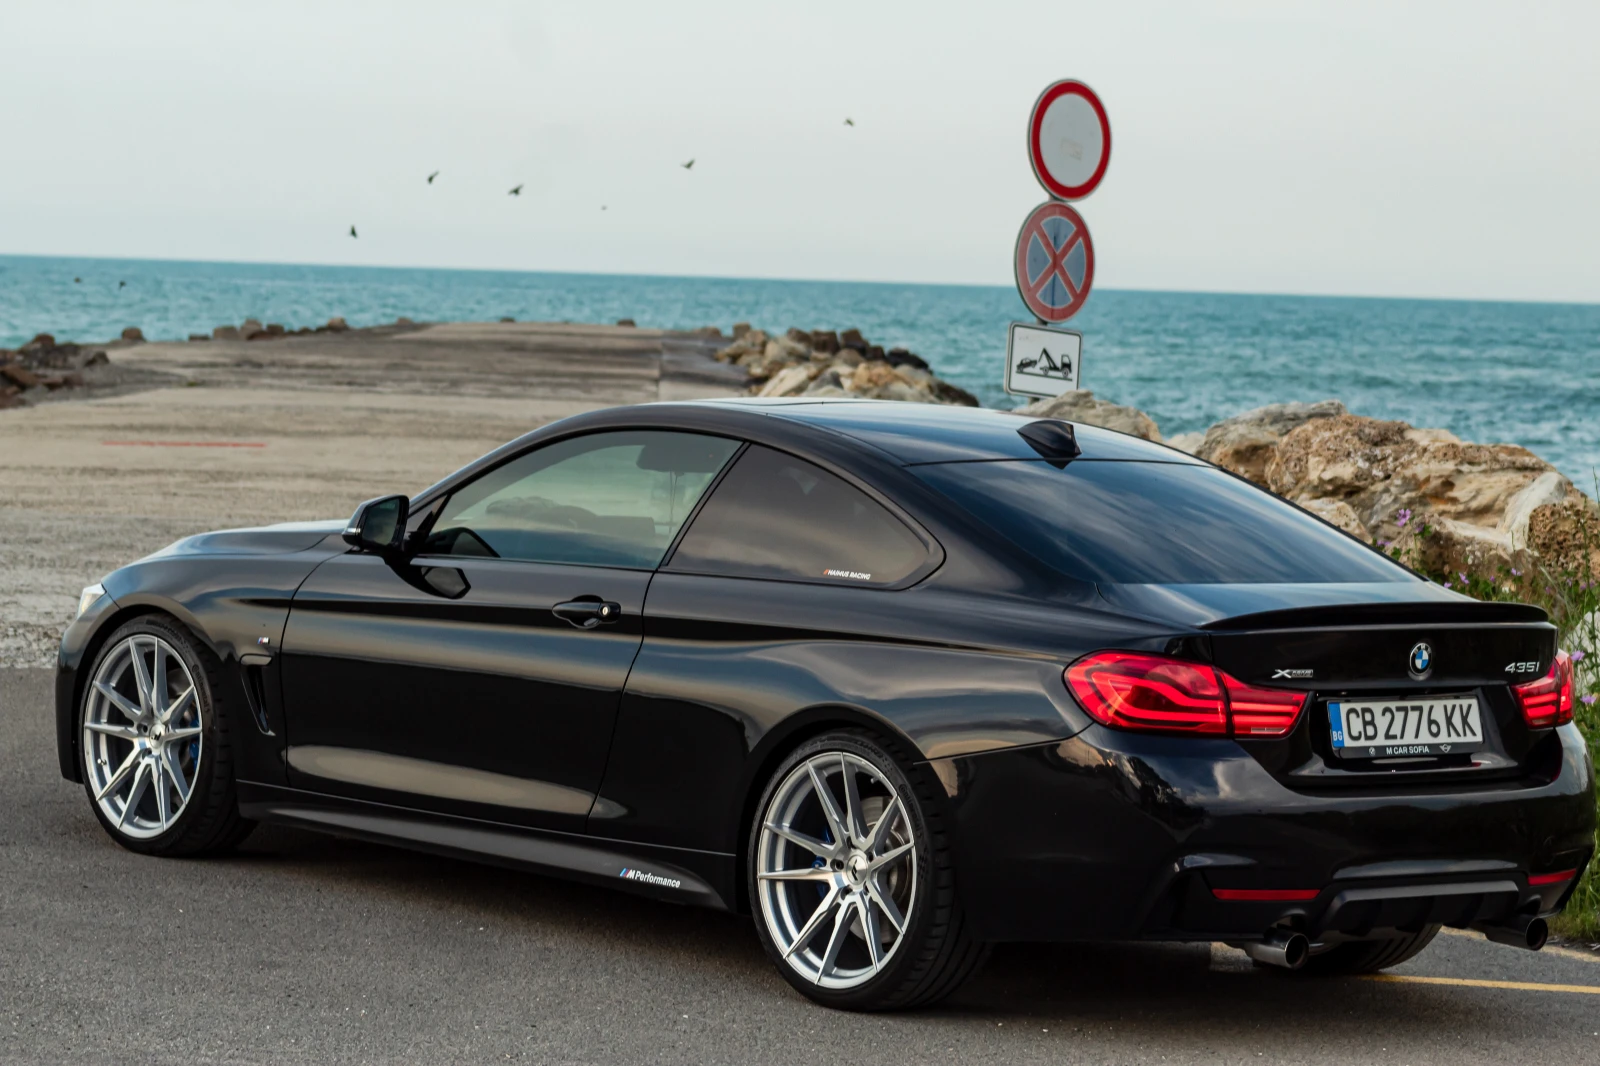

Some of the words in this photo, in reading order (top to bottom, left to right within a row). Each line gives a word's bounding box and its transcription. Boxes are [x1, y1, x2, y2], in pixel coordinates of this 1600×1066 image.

[850, 571, 871, 580] RACING
[1345, 706, 1378, 741] CB
[1381, 705, 1441, 740] 2776
[1443, 703, 1477, 738] KK
[1332, 730, 1343, 741] BG
[1386, 747, 1393, 755] M
[1393, 746, 1408, 754] CAR
[1408, 745, 1430, 754] SOFIA
[635, 870, 681, 888] Performance
